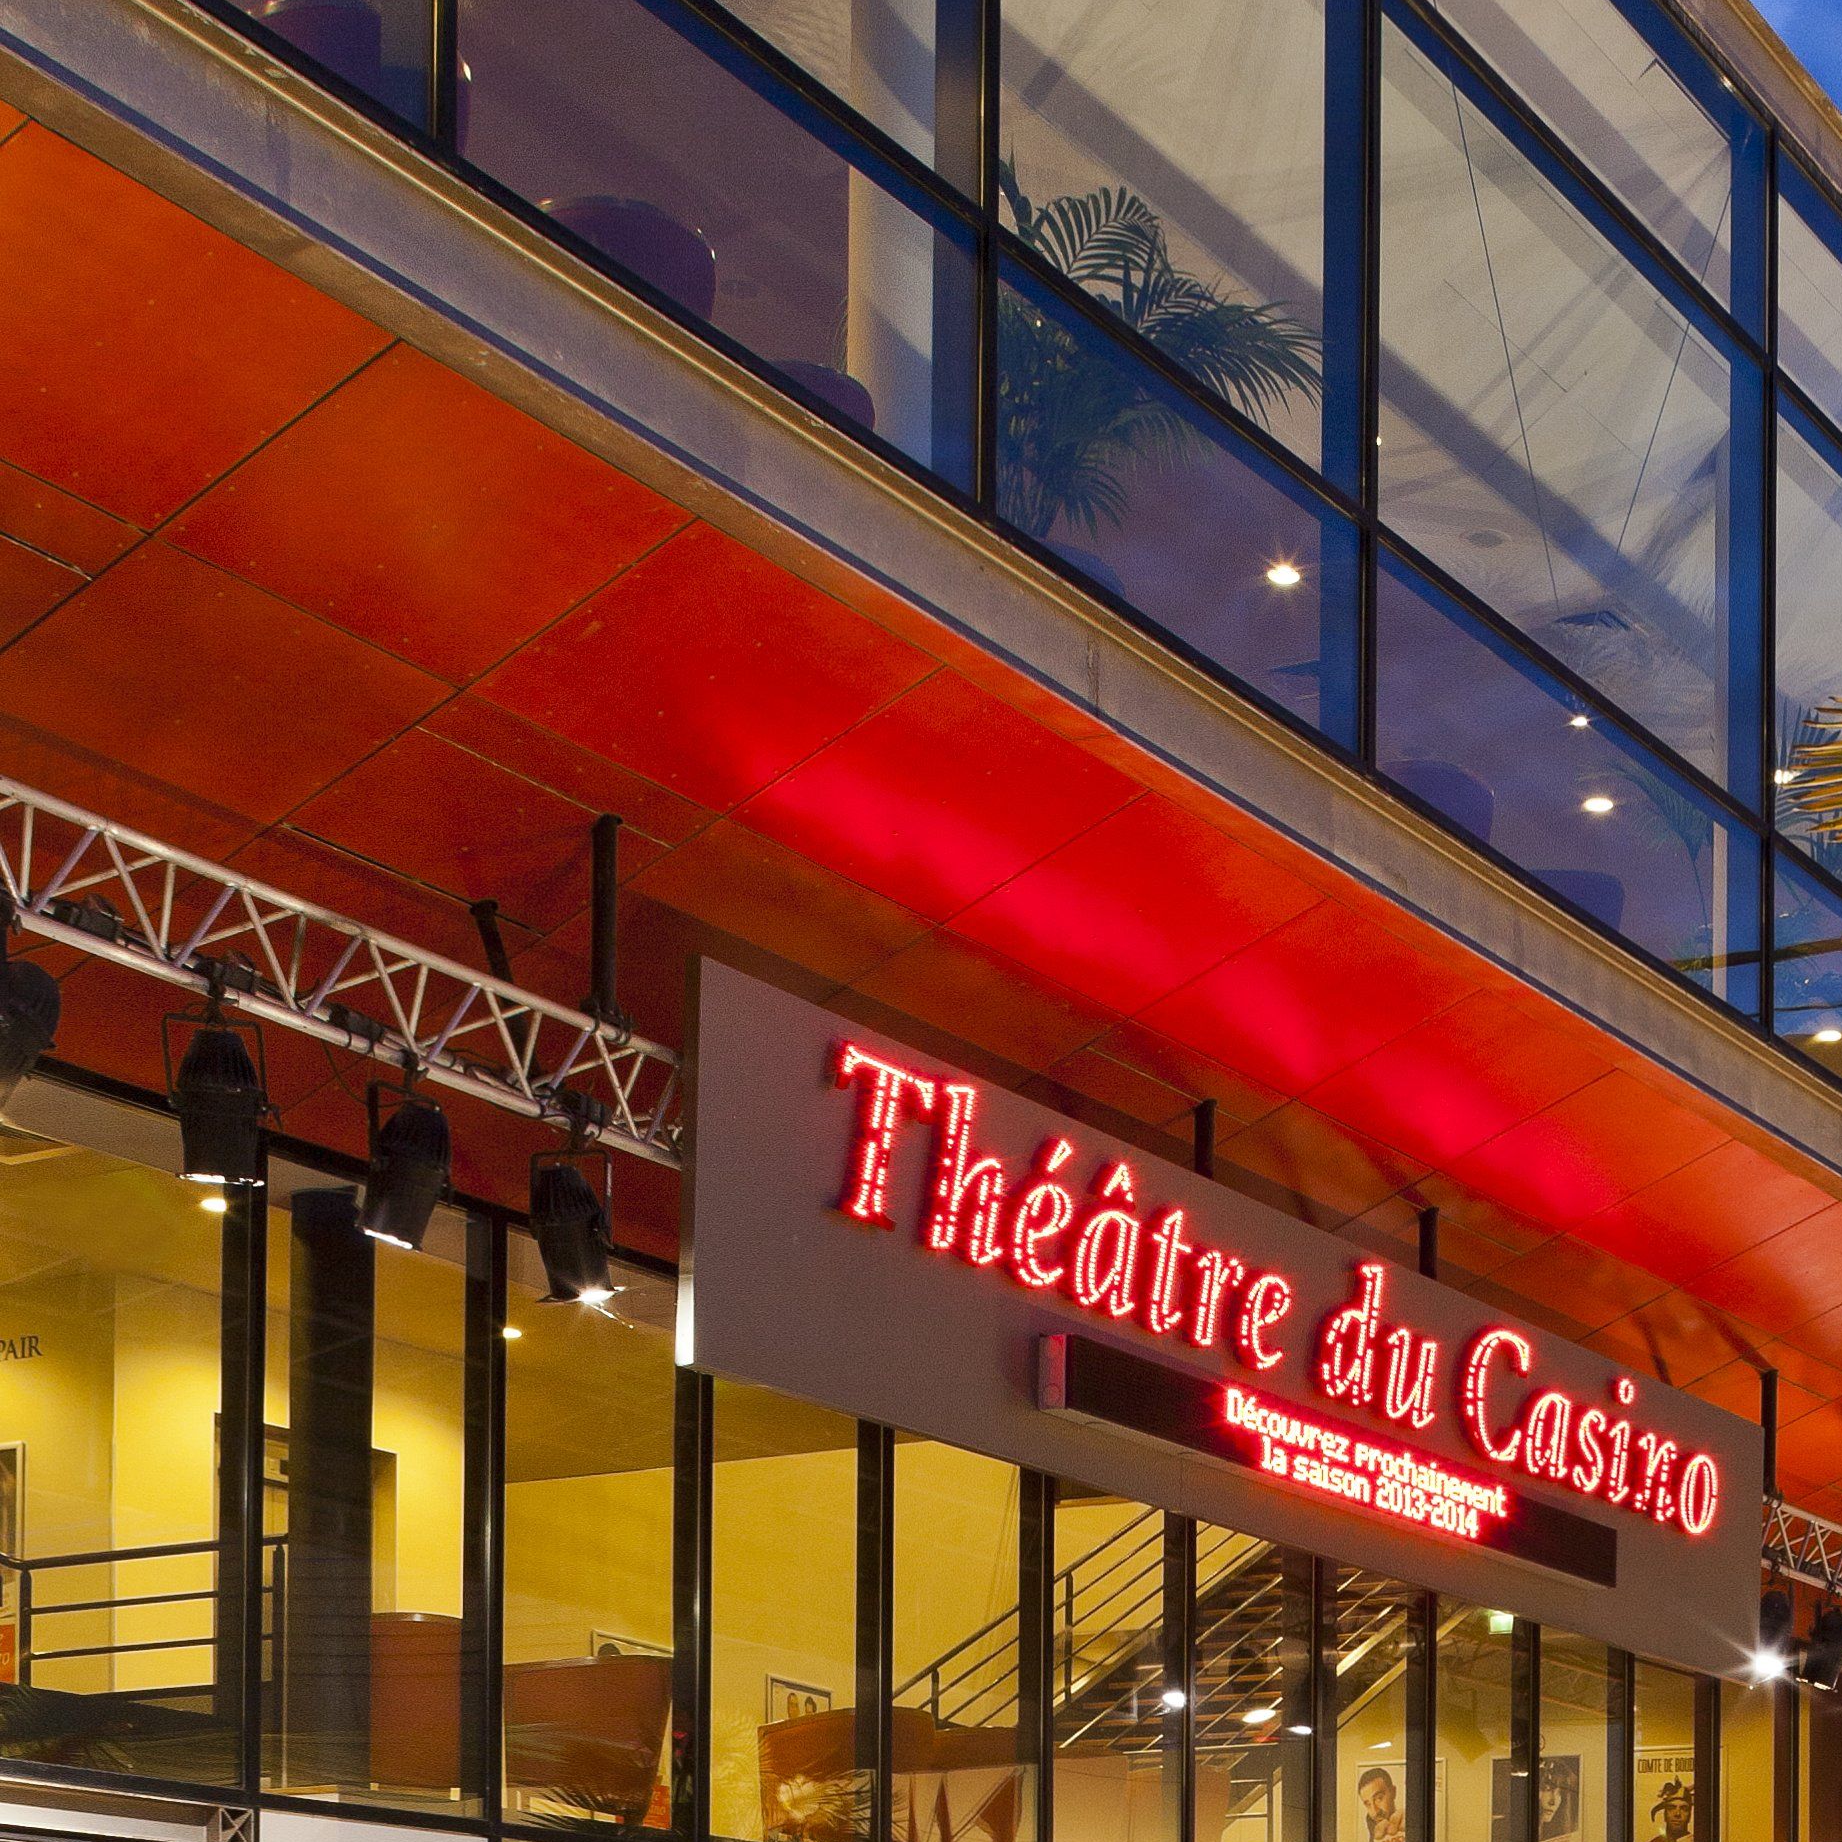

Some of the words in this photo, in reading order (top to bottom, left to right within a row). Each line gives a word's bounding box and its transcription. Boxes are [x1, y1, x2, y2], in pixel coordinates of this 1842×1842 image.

[838, 1042, 1294, 1371] Théâtre
[1321, 1264, 1437, 1429] du
[1464, 1328, 1719, 1534] Casino
[1225, 1388, 1350, 1462] Découvrez
[1355, 1443, 1507, 1517] prochainement
[1261, 1436, 1287, 1475] la
[1292, 1452, 1370, 1503] saison
[1375, 1475, 1480, 1540] 2013-2014
[1637, 1758, 1662, 1773] COMTE
[1664, 1758, 1674, 1773] DE
